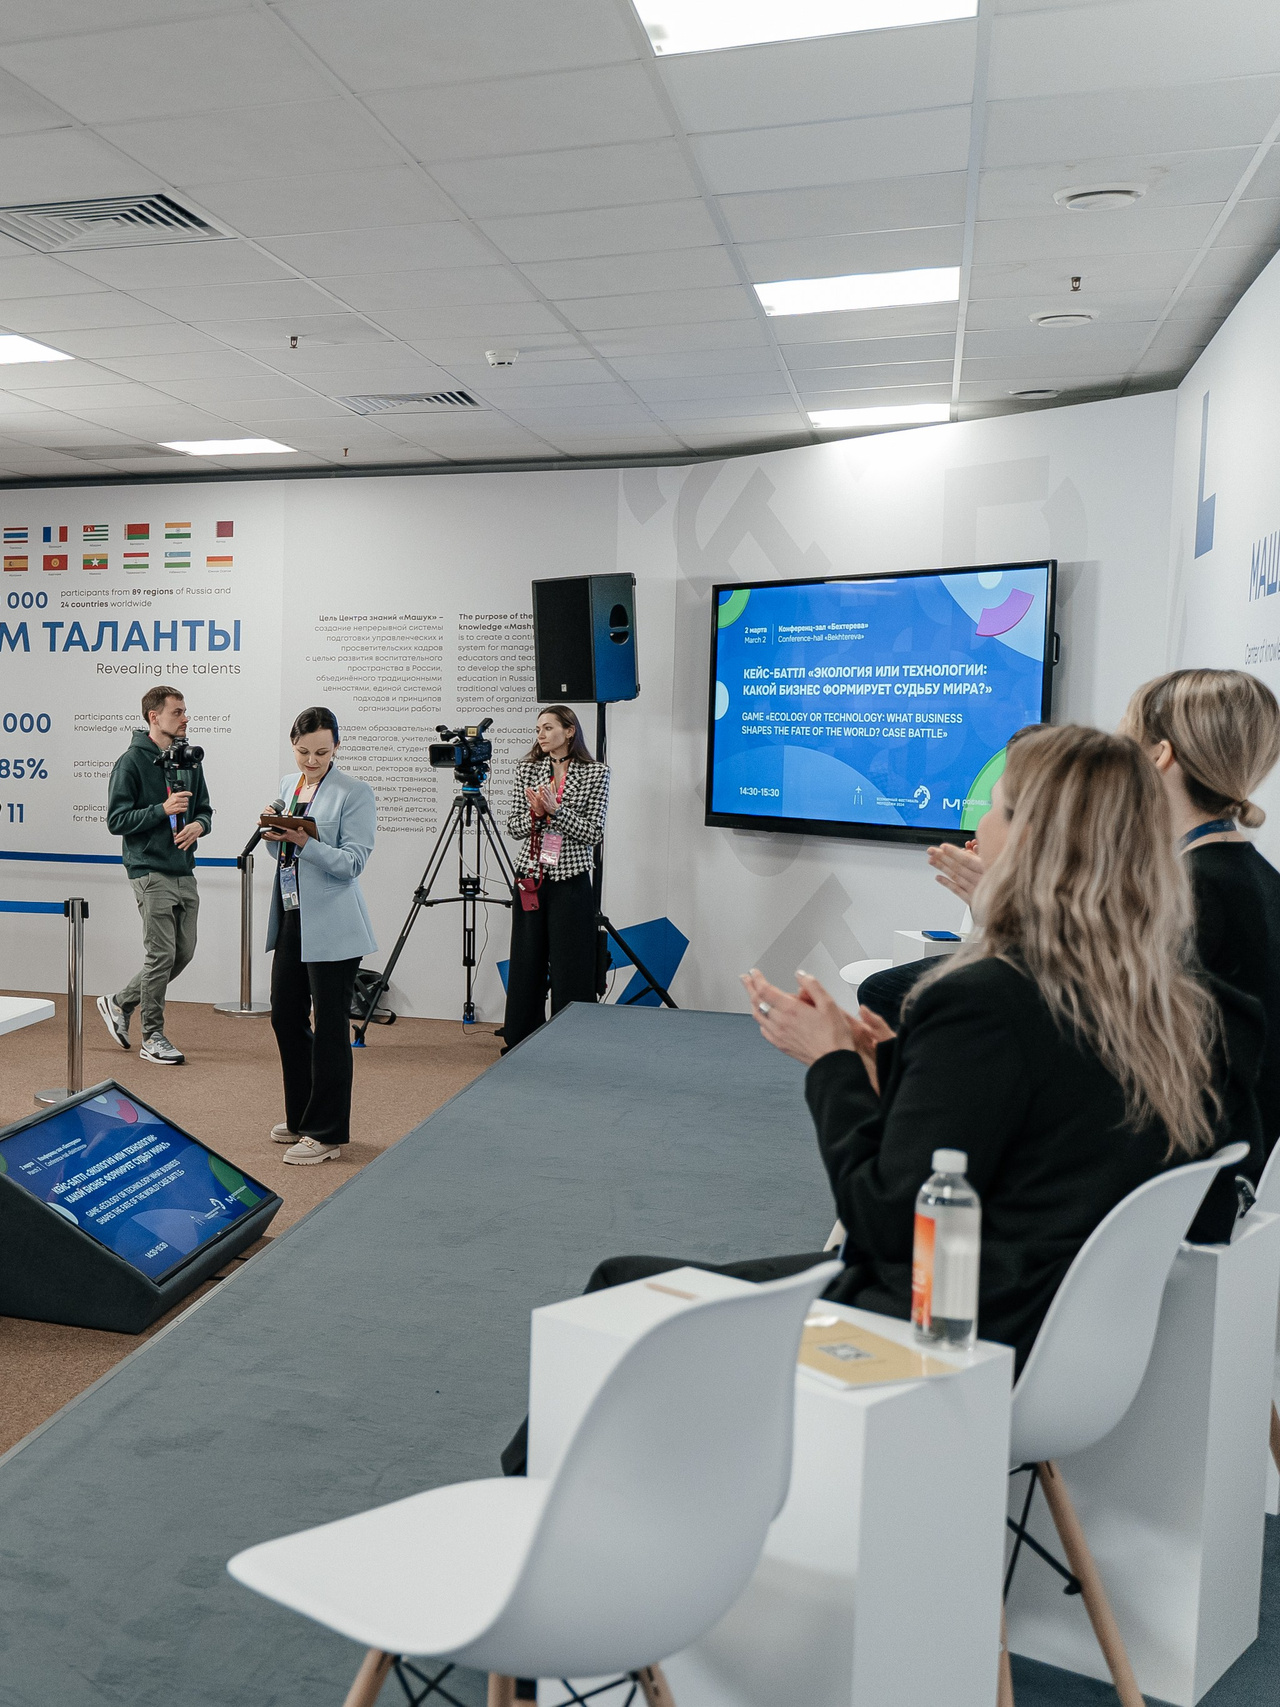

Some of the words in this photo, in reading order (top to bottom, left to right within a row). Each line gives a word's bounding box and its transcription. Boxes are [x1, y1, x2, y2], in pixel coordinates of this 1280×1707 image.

[1248, 529, 1280, 602] МАШ
[60, 588, 110, 597] participants
[111, 587, 131, 596] from
[143, 588, 174, 596] regions
[175, 586, 185, 594] of
[186, 586, 212, 594] Russia
[214, 586, 231, 594] and
[7, 591, 49, 610] 000
[70, 600, 109, 608] countries
[319, 614, 337, 622] Цель
[339, 614, 367, 622] Центра
[475, 614, 508, 622] purpose
[458, 623, 502, 632] knowledge
[751, 626, 767, 635] марта
[778, 624, 826, 634] Конференц-зал
[827, 622, 869, 632] «Бехтерева»
[42, 619, 241, 652] ТАЛАНТЫ
[744, 636, 761, 644] March
[778, 634, 823, 643] Conference-hall
[824, 633, 864, 641] «Bekhtereva»
[96, 663, 162, 676] Revealing
[166, 663, 189, 674] the
[192, 663, 241, 674] talents
[743, 666, 806, 679] КЕЙС-БАТТЛ
[808, 666, 872, 679] «ЭКОЛОГИЯ
[875, 665, 900, 678] ИЛИ
[903, 664, 988, 677] ТЕХНОЛОГИИ:
[743, 684, 776, 696] КАКОЙ
[779, 685, 820, 696] БИЗНЕС
[822, 684, 891, 696] ФОРМИРУЕТ
[894, 684, 941, 696] СУДЬБУ
[943, 683, 993, 695] МИРА?»
[411, 705, 441, 713] работы
[2, 712, 54, 733] 000
[74, 713, 123, 722] participants
[741, 712, 764, 722] GAME
[765, 712, 808, 722] «ECOLOGY
[809, 712, 822, 722] OR
[824, 712, 885, 723] TECHNOLOGY:
[886, 713, 914, 723] WHAT
[915, 713, 963, 724] BUSINESS
[74, 724, 118, 733] knowledge
[741, 726, 772, 735] SHAPES
[773, 726, 790, 736] THE
[791, 726, 810, 736] FATE
[812, 727, 824, 737] OF
[825, 727, 842, 737] THE
[843, 727, 880, 737] WORLD?
[882, 727, 906, 738] CASE
[908, 728, 948, 739] BATTLE»
[739, 786, 780, 798] 14:30-15:30
[7, 803, 24, 823] 11
